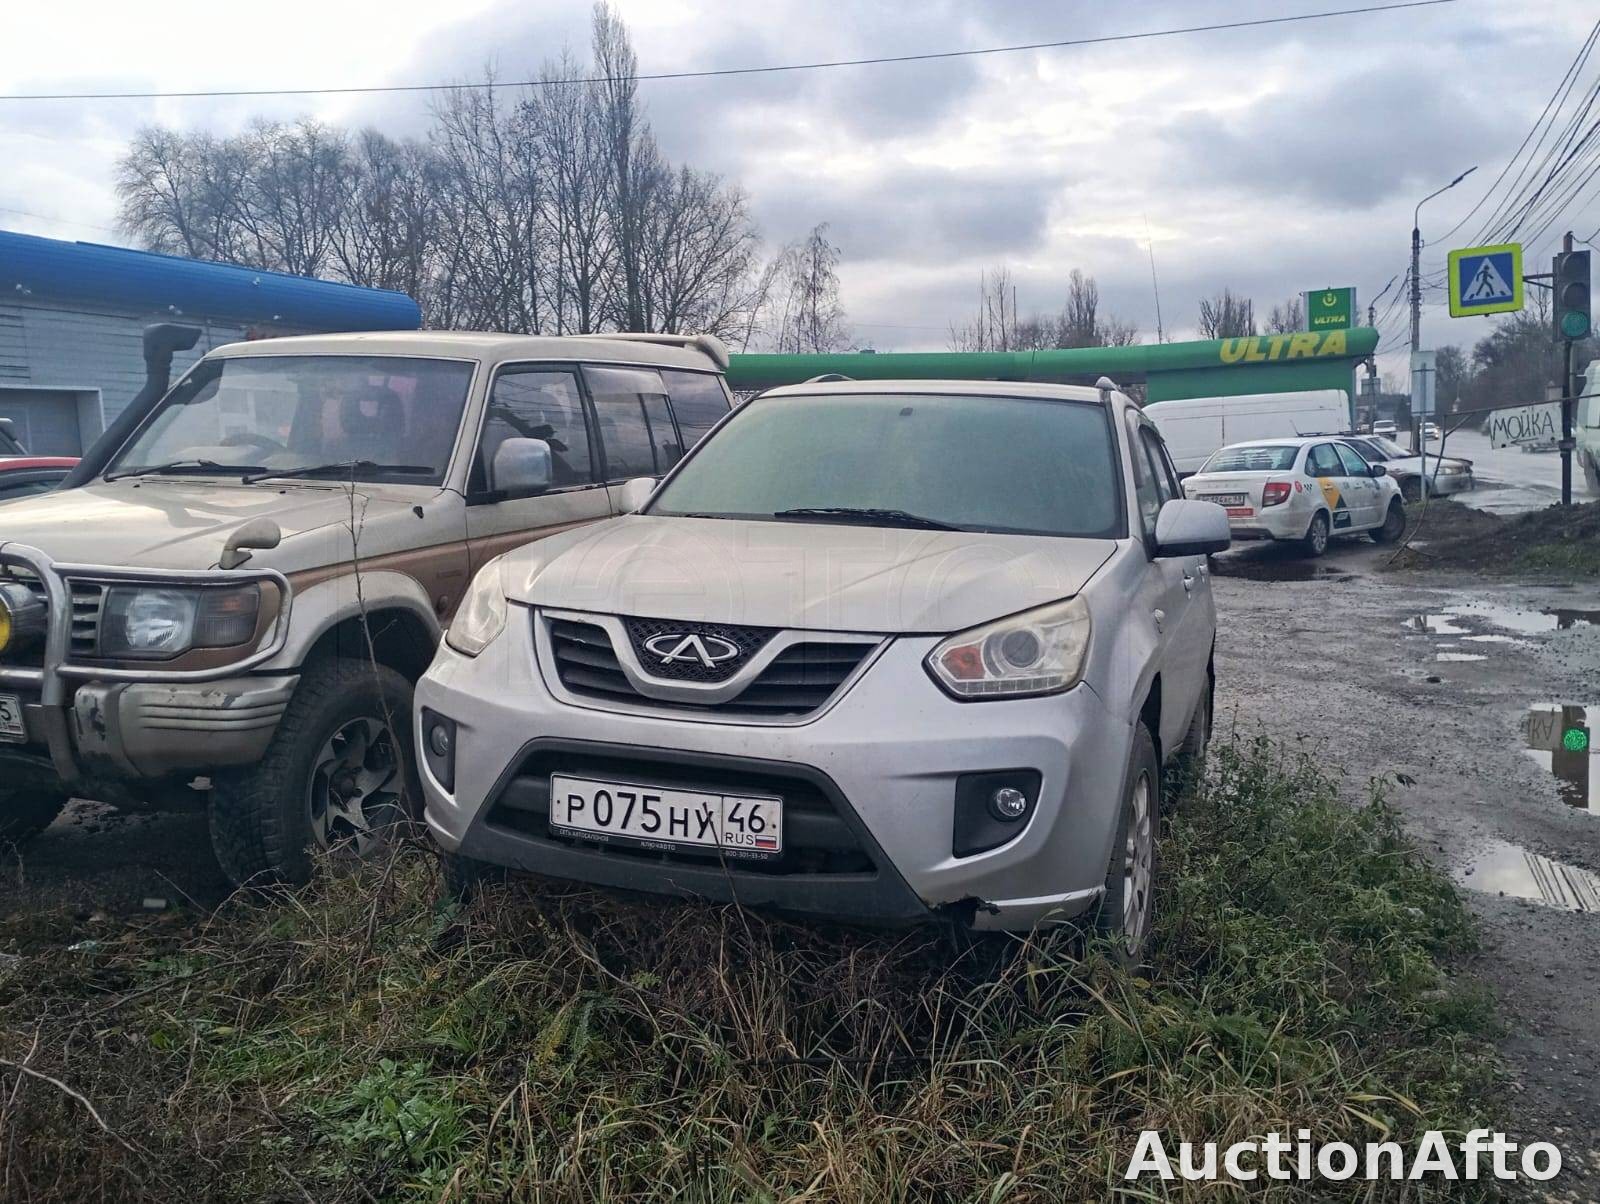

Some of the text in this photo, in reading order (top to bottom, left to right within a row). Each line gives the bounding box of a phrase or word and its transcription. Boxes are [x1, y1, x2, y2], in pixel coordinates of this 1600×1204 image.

[1314, 314, 1346, 325] ULTRA
[1220, 330, 1347, 364] ULTRA
[1491, 409, 1554, 441] МОЙКА
[727, 802, 766, 833] 46
[725, 833, 754, 846] RUS
